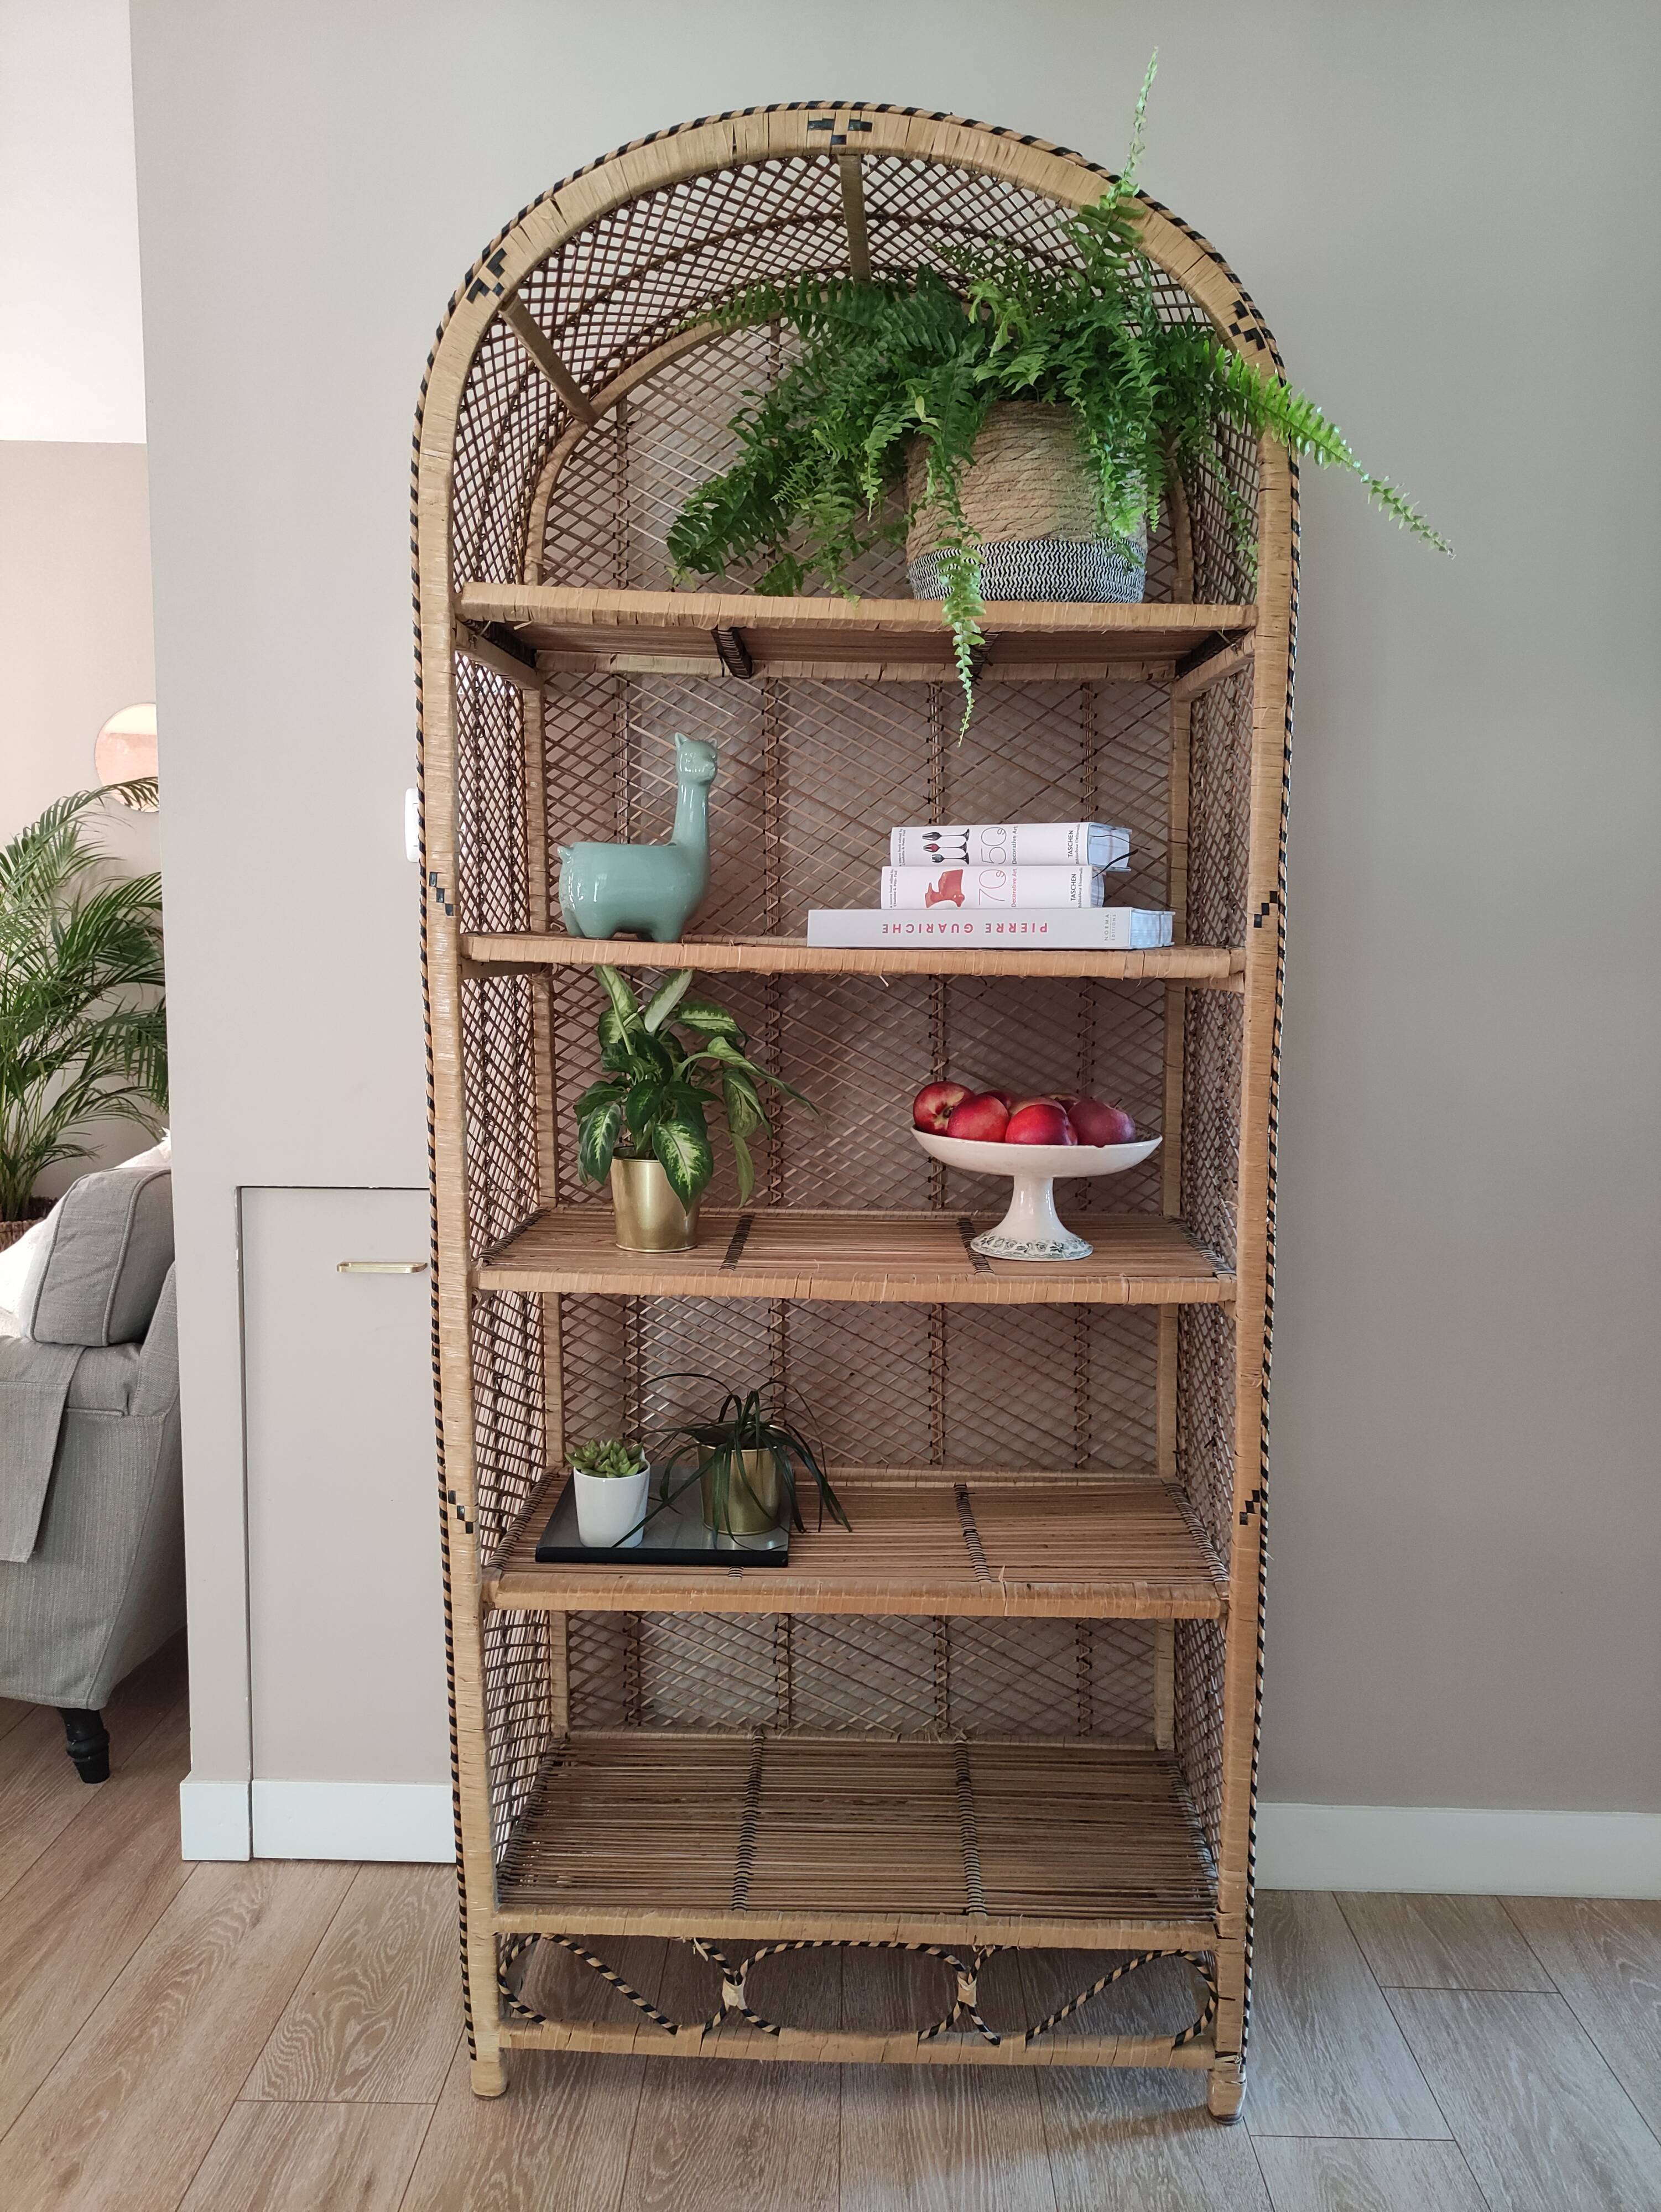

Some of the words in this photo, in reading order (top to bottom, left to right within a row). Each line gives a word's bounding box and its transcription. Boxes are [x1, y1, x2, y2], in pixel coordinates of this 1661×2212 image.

[981, 827, 1007, 864] 50s
[978, 869, 1006, 906] 70s
[882, 923, 973, 933] GUARICHE
[985, 922, 1048, 933] PIERRE
